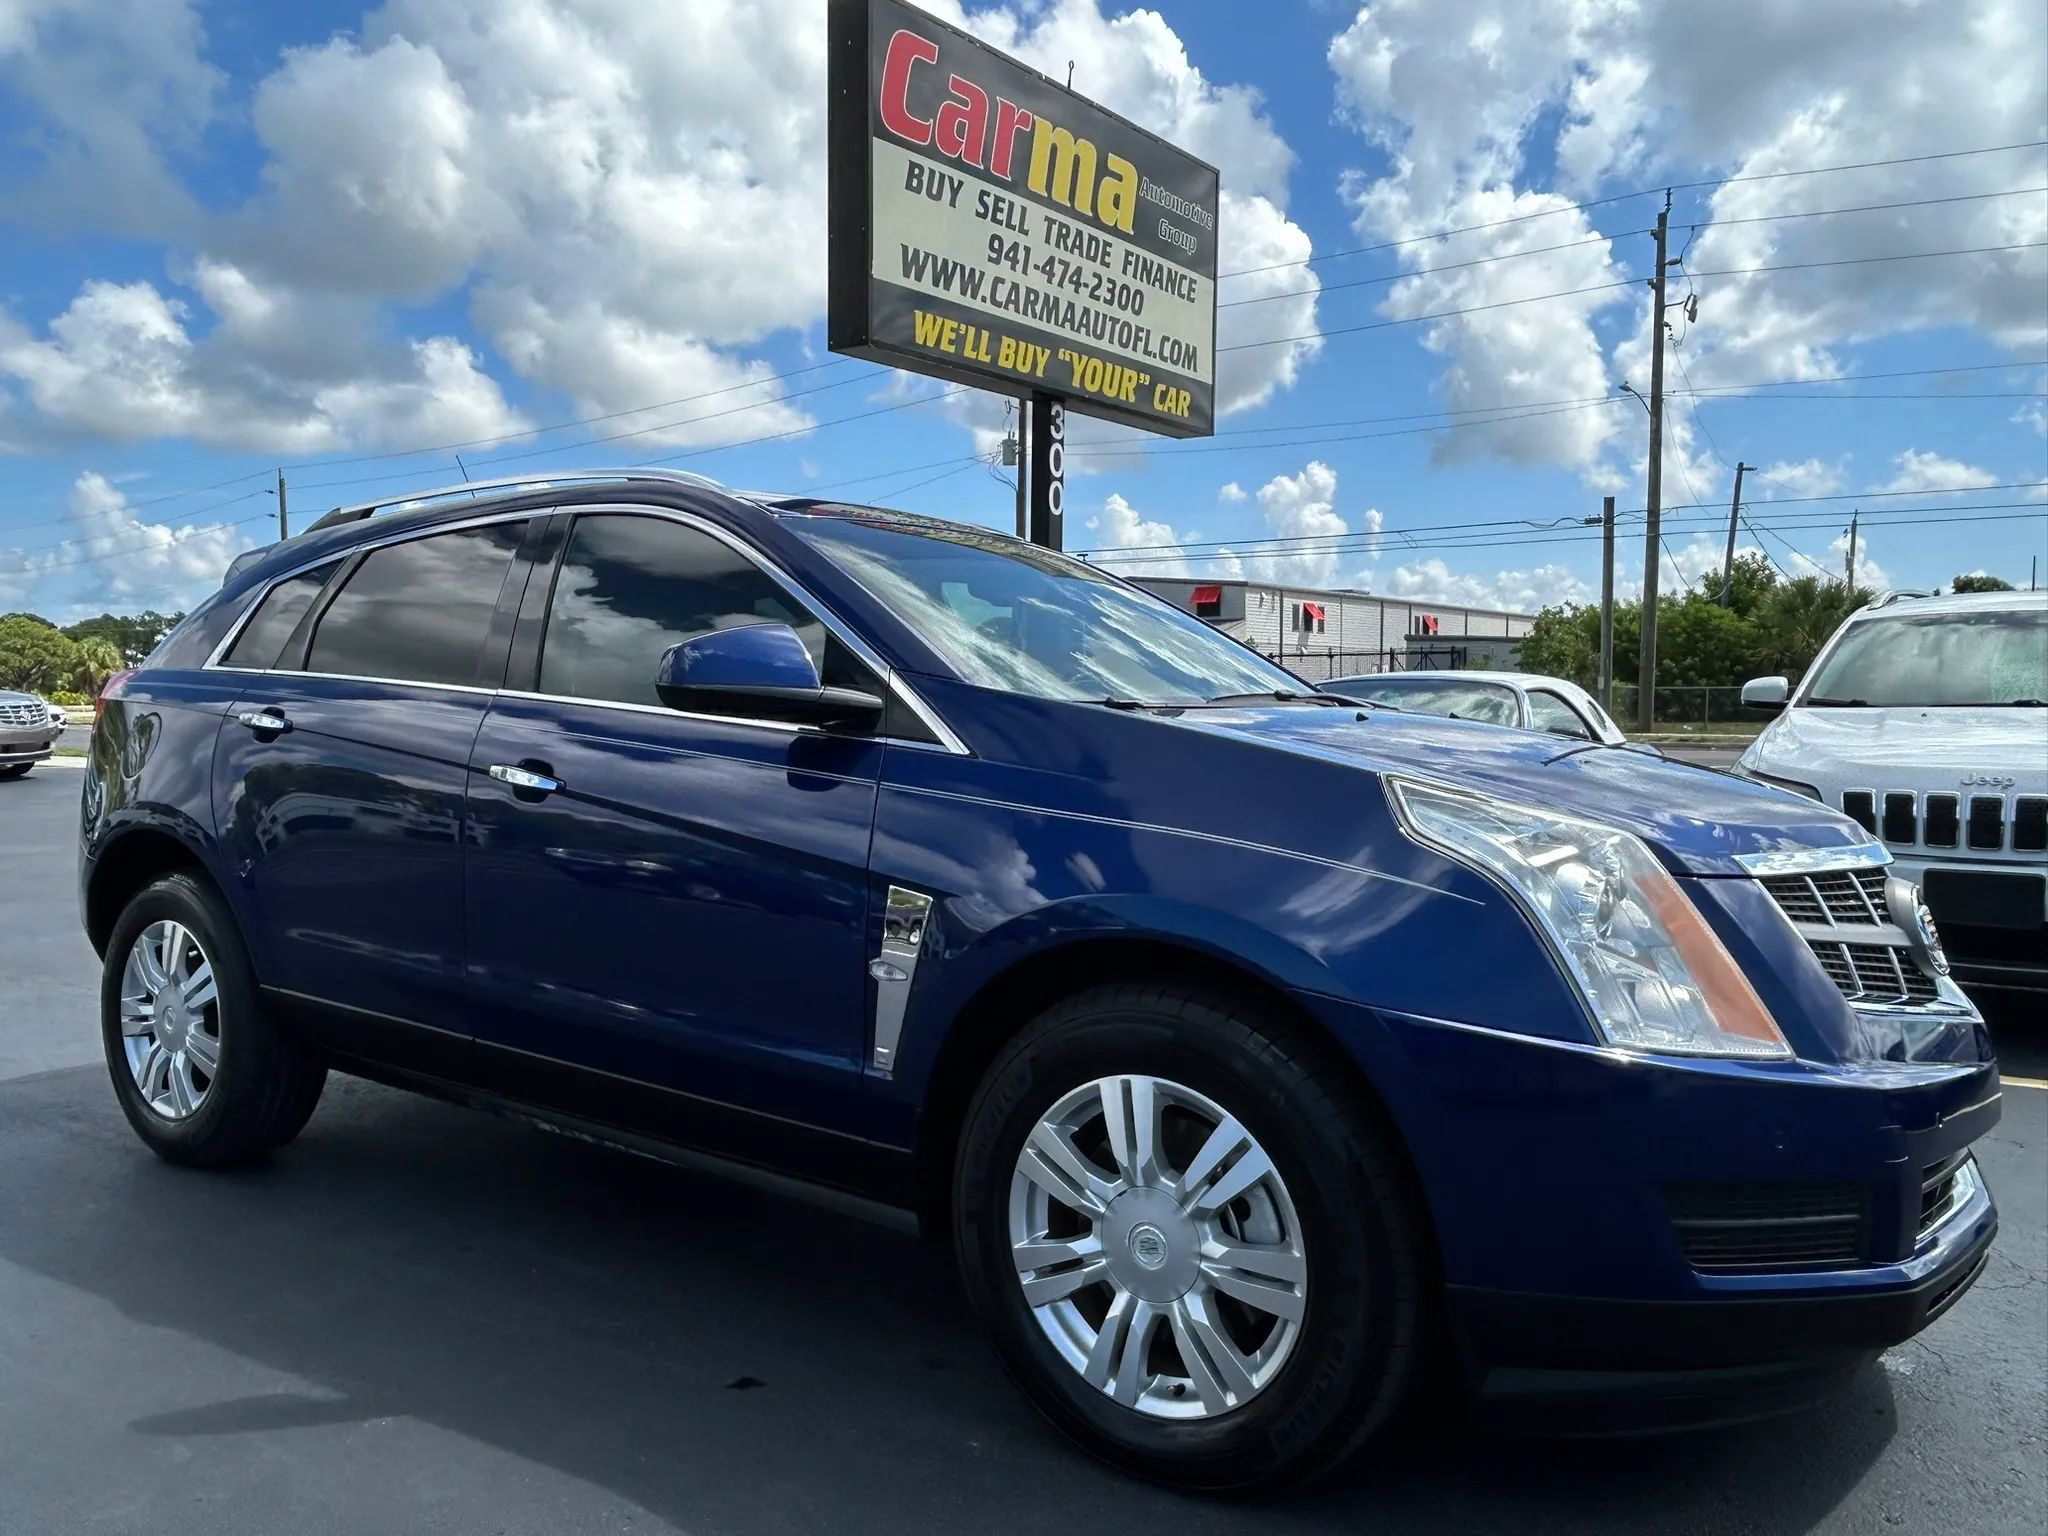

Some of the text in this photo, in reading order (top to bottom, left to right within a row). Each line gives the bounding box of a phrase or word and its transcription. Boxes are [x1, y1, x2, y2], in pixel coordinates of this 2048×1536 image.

[880, 29, 1139, 235] Carma
[905, 160, 1197, 303] BUY SELL TRADE FINANCE
[1140, 177, 1213, 230] Automotive
[1159, 219, 1197, 255] Group
[901, 243, 1198, 372] WWW.CARMAAUTOFL.COM
[987, 234, 1144, 316] 941-474-2300
[914, 309, 1191, 418] WE'LL BUY "YOUR" CAR
[1049, 404, 1065, 516] 300
[1960, 772, 2016, 789] Jeep
